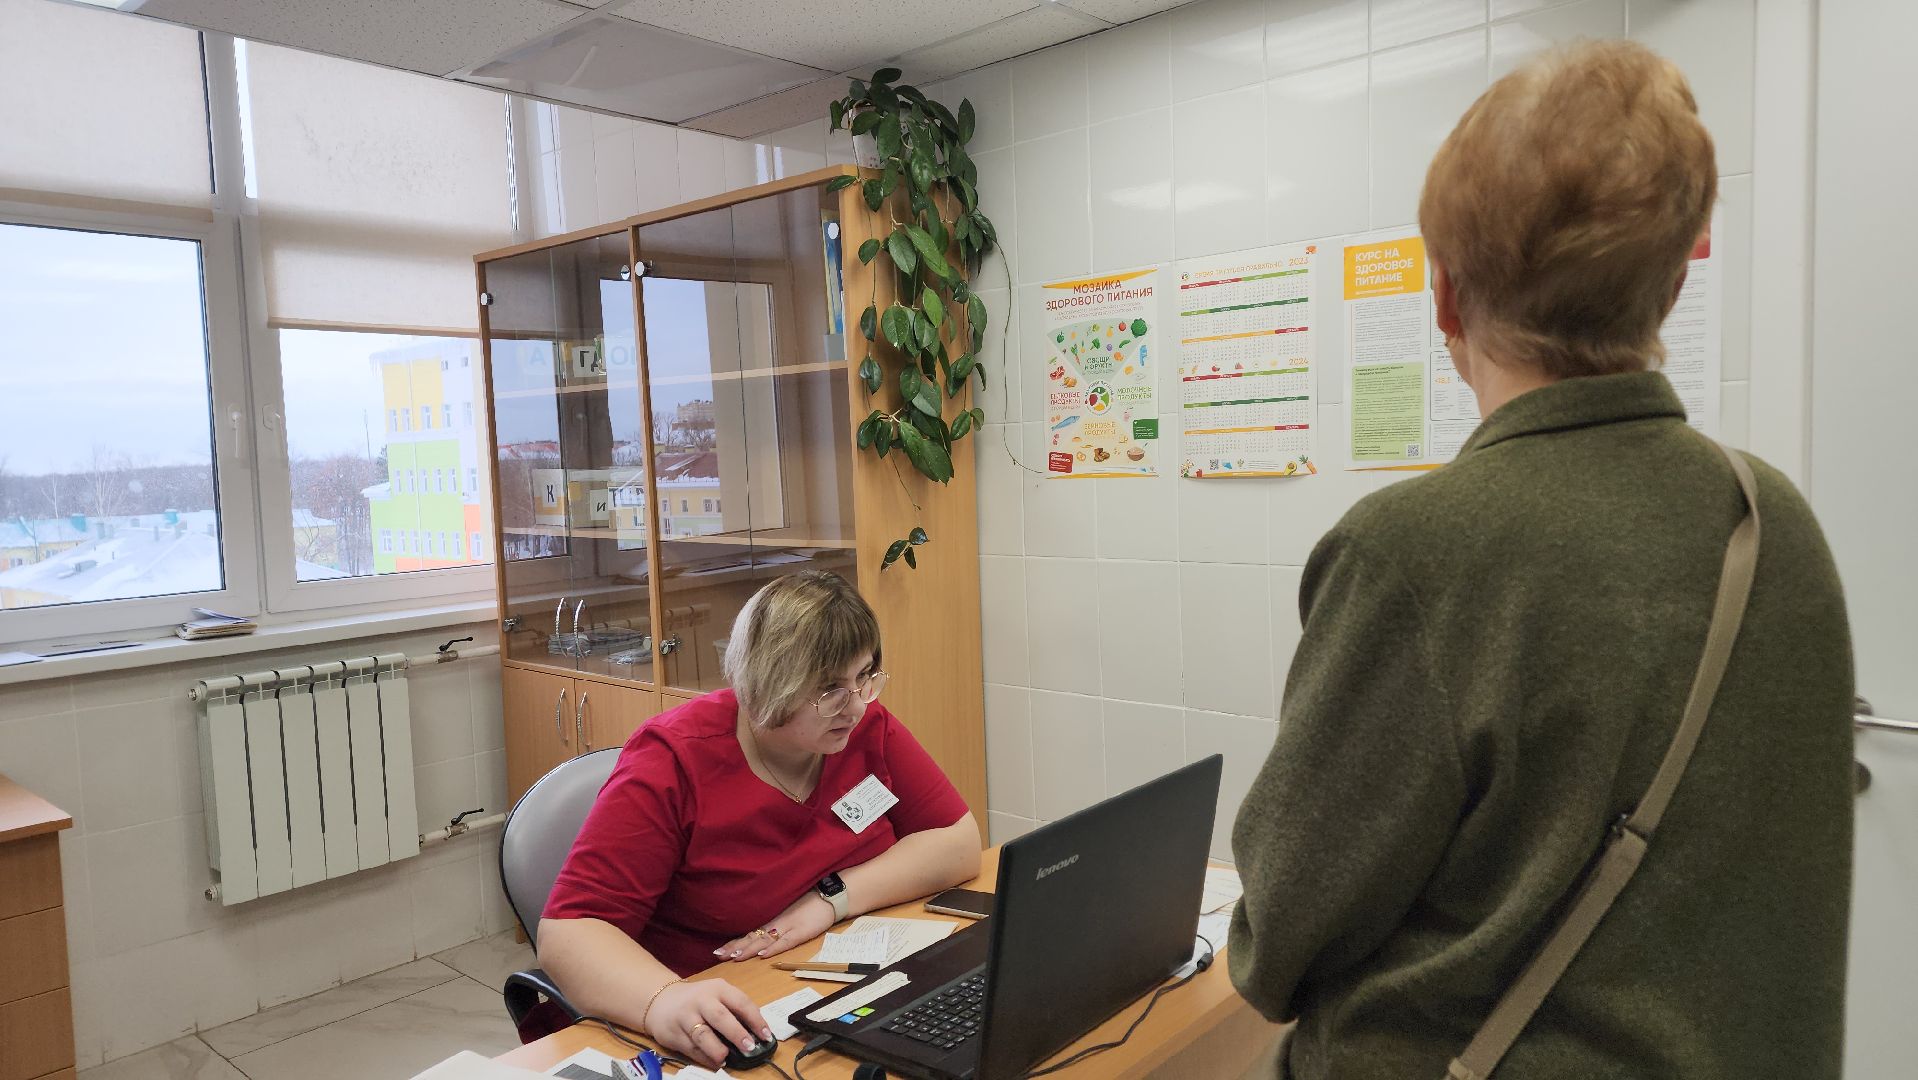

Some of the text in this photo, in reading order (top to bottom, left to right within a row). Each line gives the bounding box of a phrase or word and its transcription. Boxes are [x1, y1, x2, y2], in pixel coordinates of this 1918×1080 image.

[1355, 247, 1400, 262] КУРС НА
[1355, 257, 1414, 275] ЗДОРОВОЕ
[1073, 280, 1122, 294] МОЗАИКА
[1355, 271, 1403, 287] ПИТАНИЕ
[1046, 294, 1105, 311] ЗДОРОВОГО
[1107, 287, 1153, 302] ПИТАНИЯ
[1035, 854, 1080, 881] lenovo
